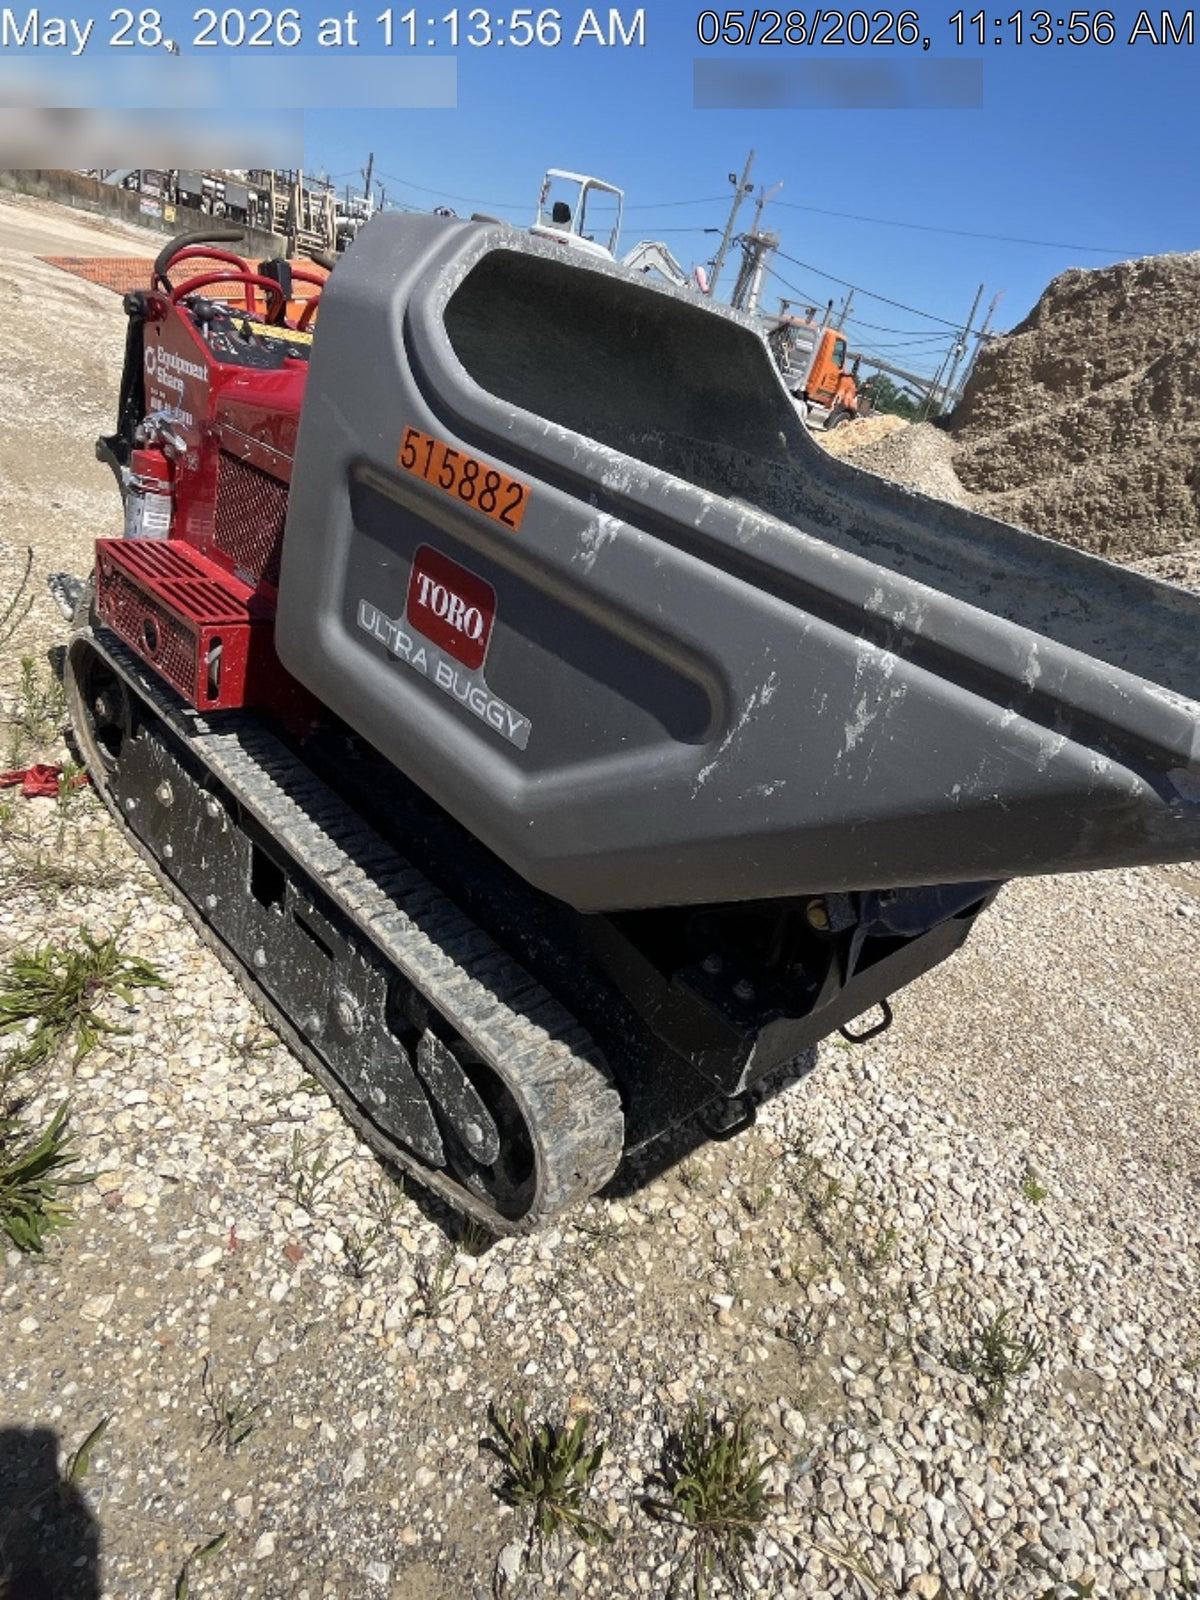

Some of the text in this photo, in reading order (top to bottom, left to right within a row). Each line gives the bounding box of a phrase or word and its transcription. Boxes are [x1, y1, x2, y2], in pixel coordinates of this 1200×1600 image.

[157, 346, 208, 383] Equipment
[157, 366, 184, 392] Share
[400, 428, 524, 527] 515882
[417, 572, 484, 640] TORO
[361, 604, 524, 738] ULTRA BUGGY
